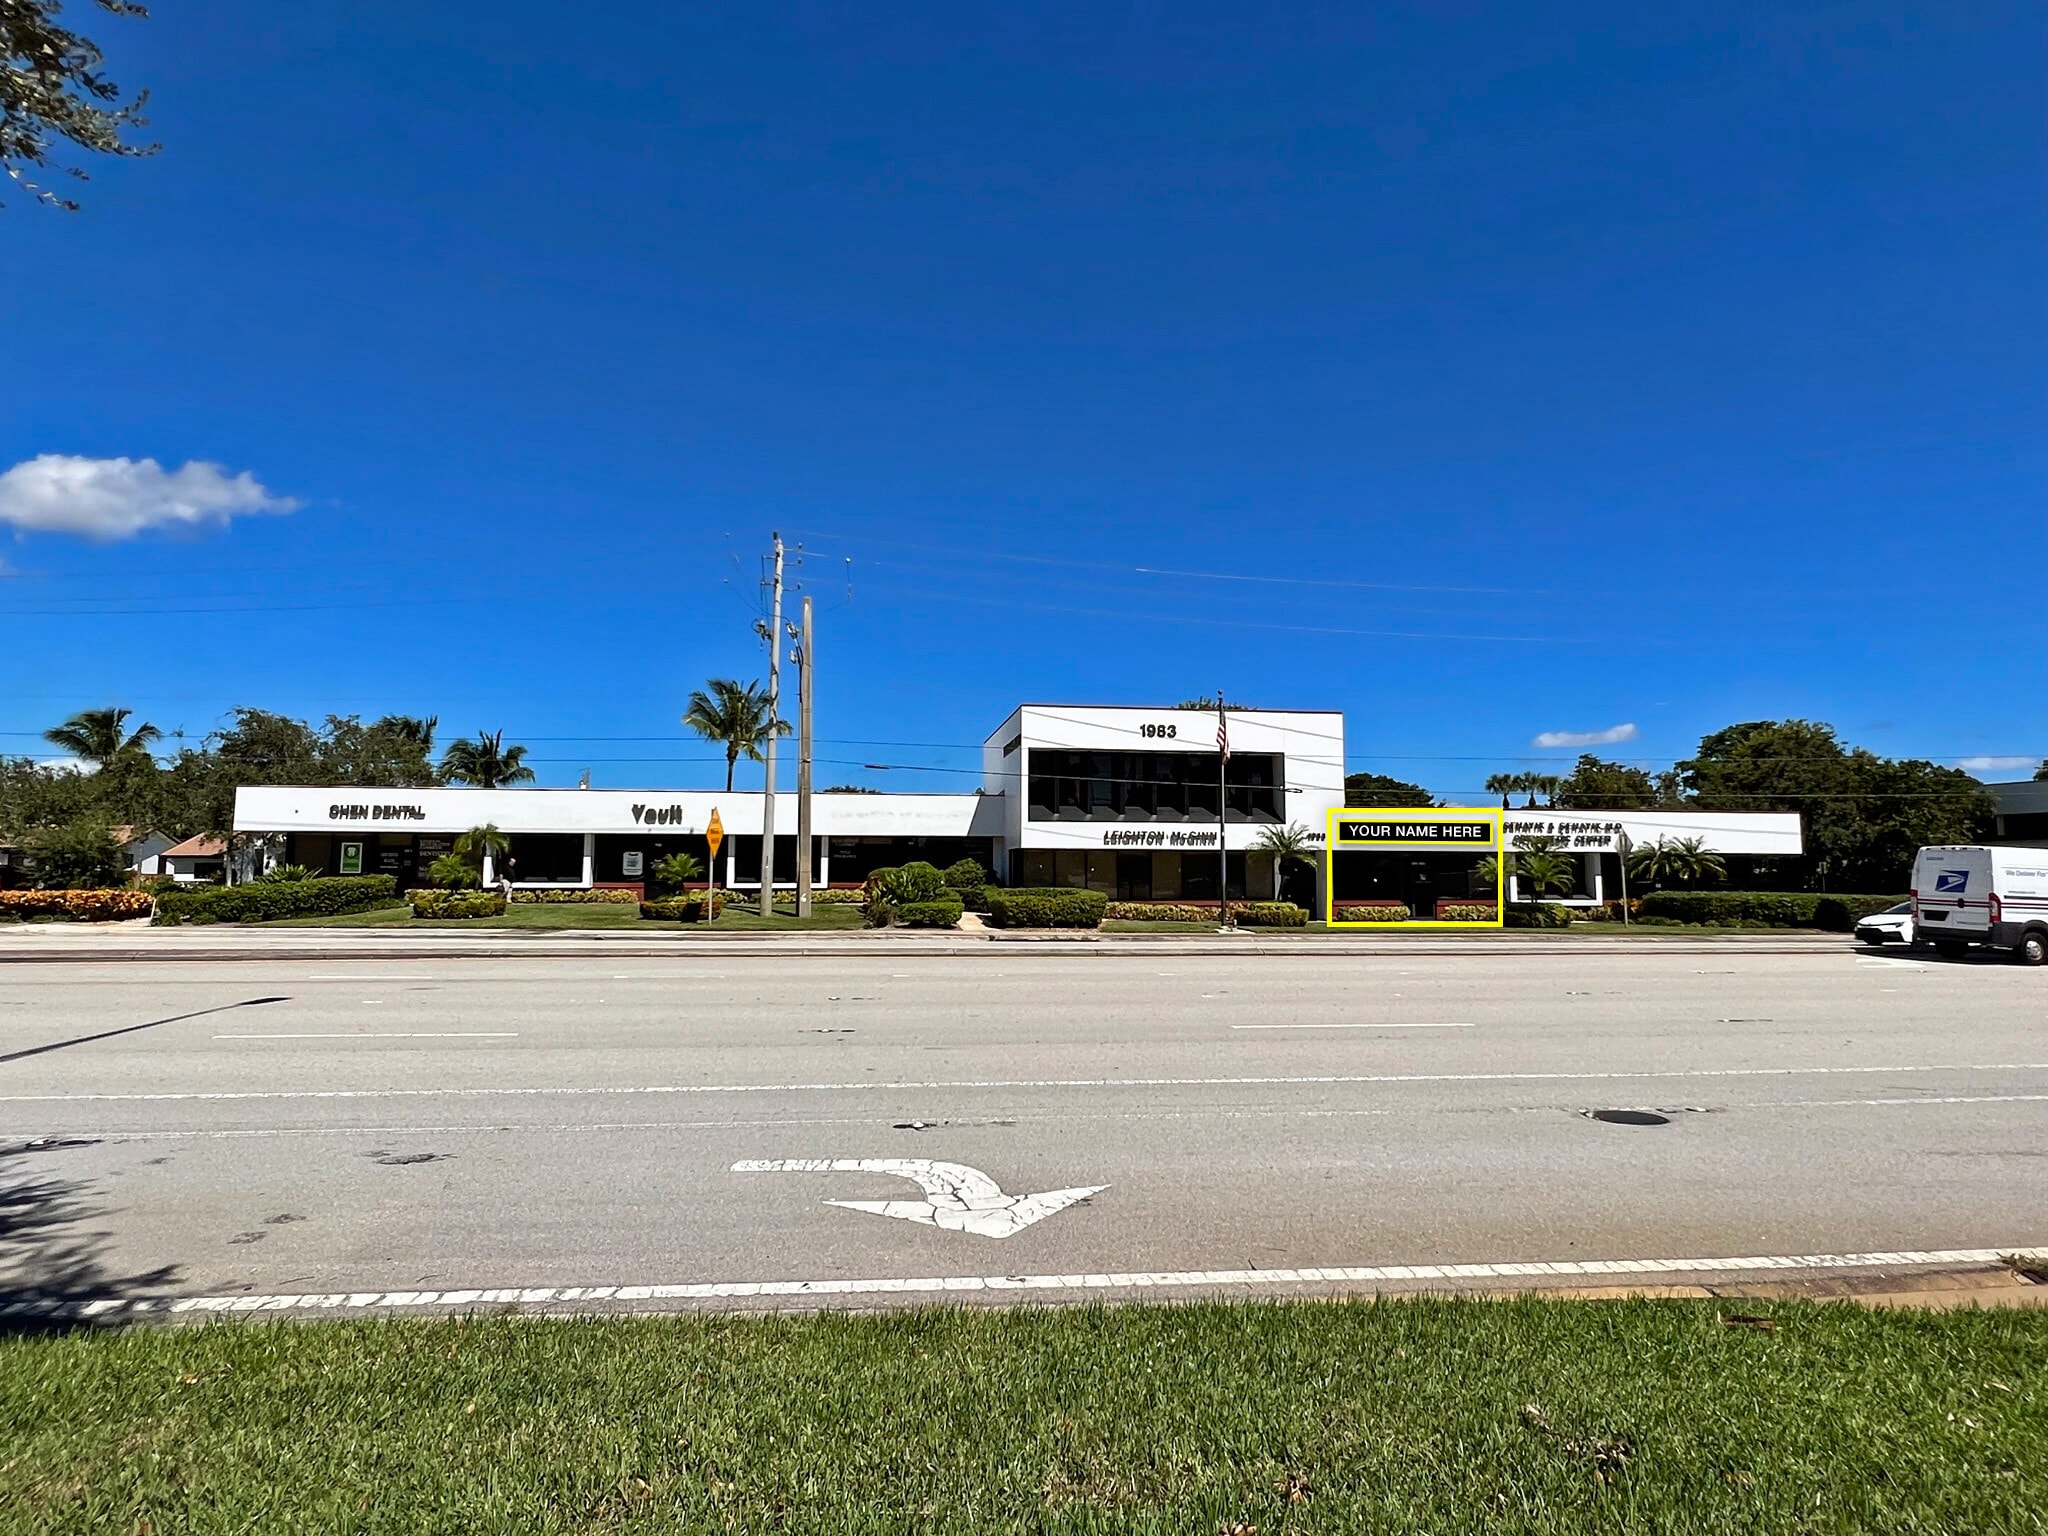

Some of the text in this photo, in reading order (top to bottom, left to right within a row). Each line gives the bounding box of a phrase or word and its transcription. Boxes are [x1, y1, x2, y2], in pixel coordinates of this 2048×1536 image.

[1140, 723, 1177, 738] 1983
[372, 804, 426, 820] DENTAL
[631, 804, 683, 825] Vault
